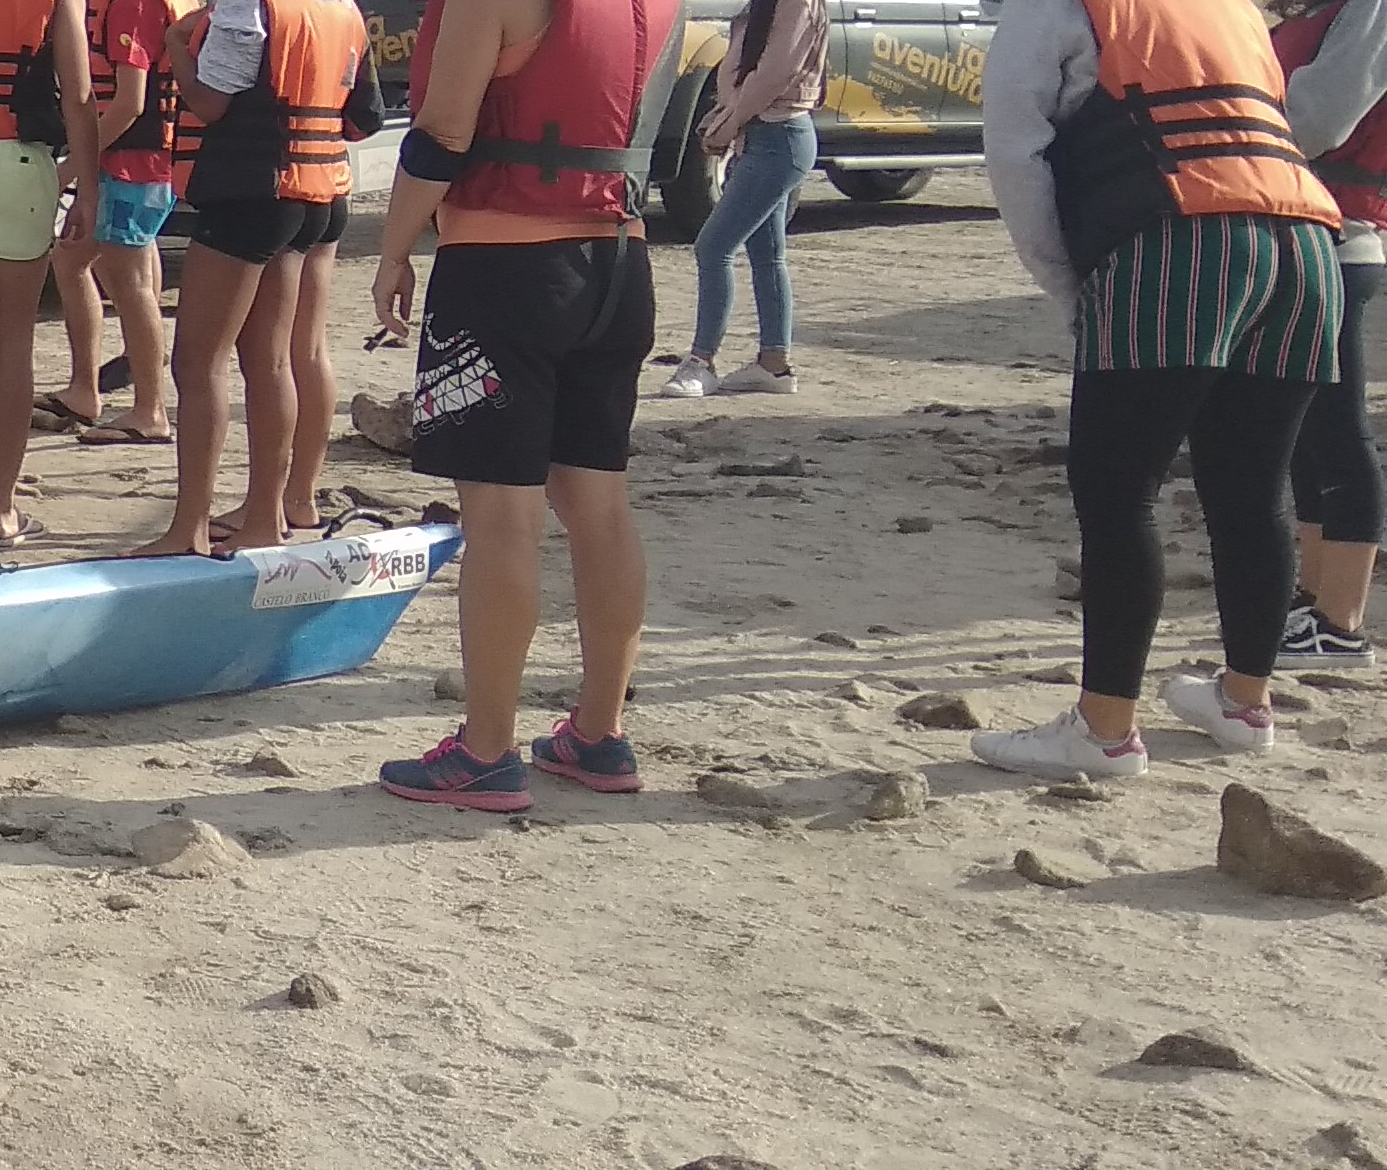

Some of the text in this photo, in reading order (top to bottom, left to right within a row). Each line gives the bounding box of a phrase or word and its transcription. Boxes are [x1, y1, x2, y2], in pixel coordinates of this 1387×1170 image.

[366, 16, 385, 42] a
[957, 41, 986, 76] ra
[391, 552, 426, 577] RBB
[294, 589, 330, 604] BRANCO
